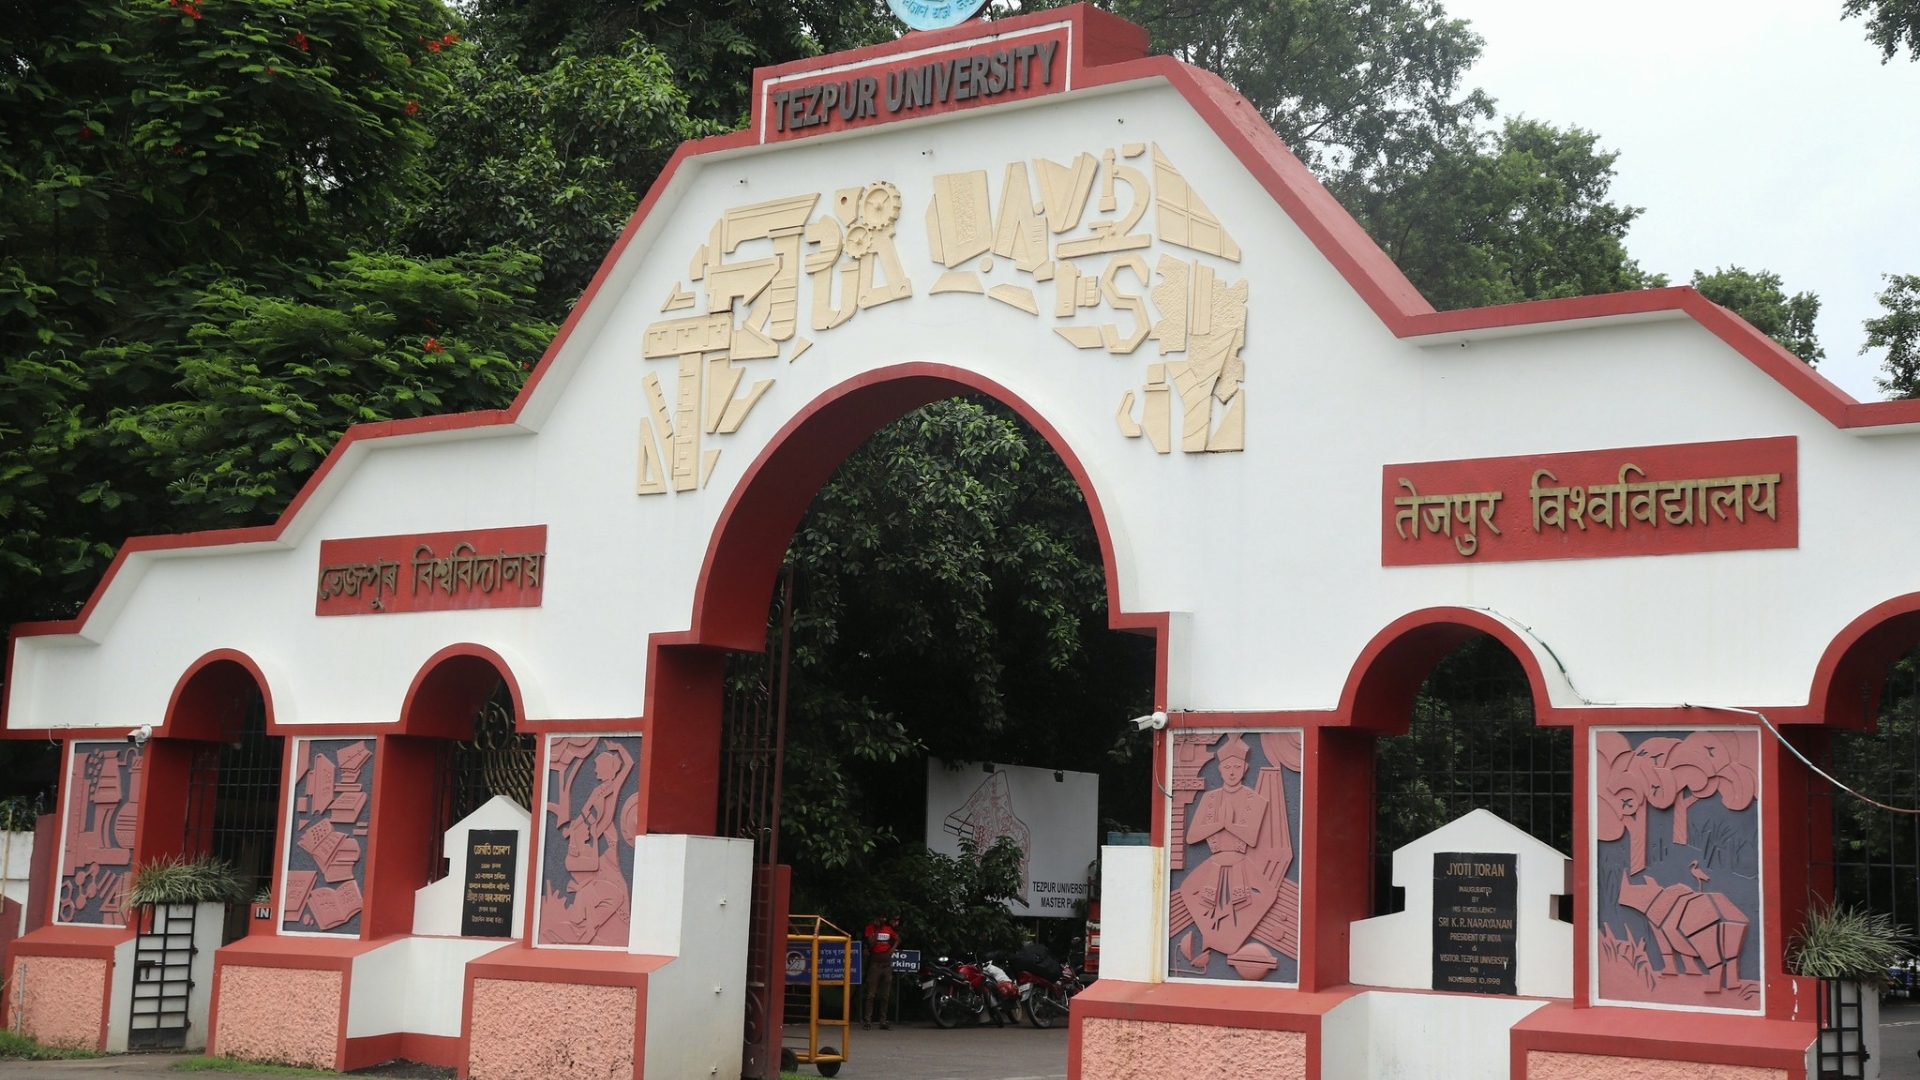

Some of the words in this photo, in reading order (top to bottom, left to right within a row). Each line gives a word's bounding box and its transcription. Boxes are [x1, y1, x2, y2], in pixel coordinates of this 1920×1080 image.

[773, 78, 877, 131] TEZPUR
[885, 40, 1058, 112] UNIVERSITY
[1394, 477, 1503, 557] तेजपुर
[1528, 463, 1781, 533] विश्वविद्यालय
[318, 557, 401, 610] তেজপুৰ
[1446, 862, 1472, 876] JYOTI
[1474, 863, 1505, 877] TORAN
[1032, 881, 1056, 893] TEZPUR
[1057, 882, 1088, 894] UNIVERSIT
[1041, 896, 1066, 909] MASTER
[255, 907, 269, 918] IN
[1438, 916, 1449, 927] SRI
[1467, 918, 1513, 929] NARAYANAN
[1449, 932, 1478, 941] PRESIDENT
[1479, 933, 1486, 941] OF
[1487, 934, 1502, 943] INDIA
[892, 960, 917, 970] rking
[1480, 955, 1509, 965] UNIVERSITY
[1447, 976, 1477, 984] NOVEMBER
